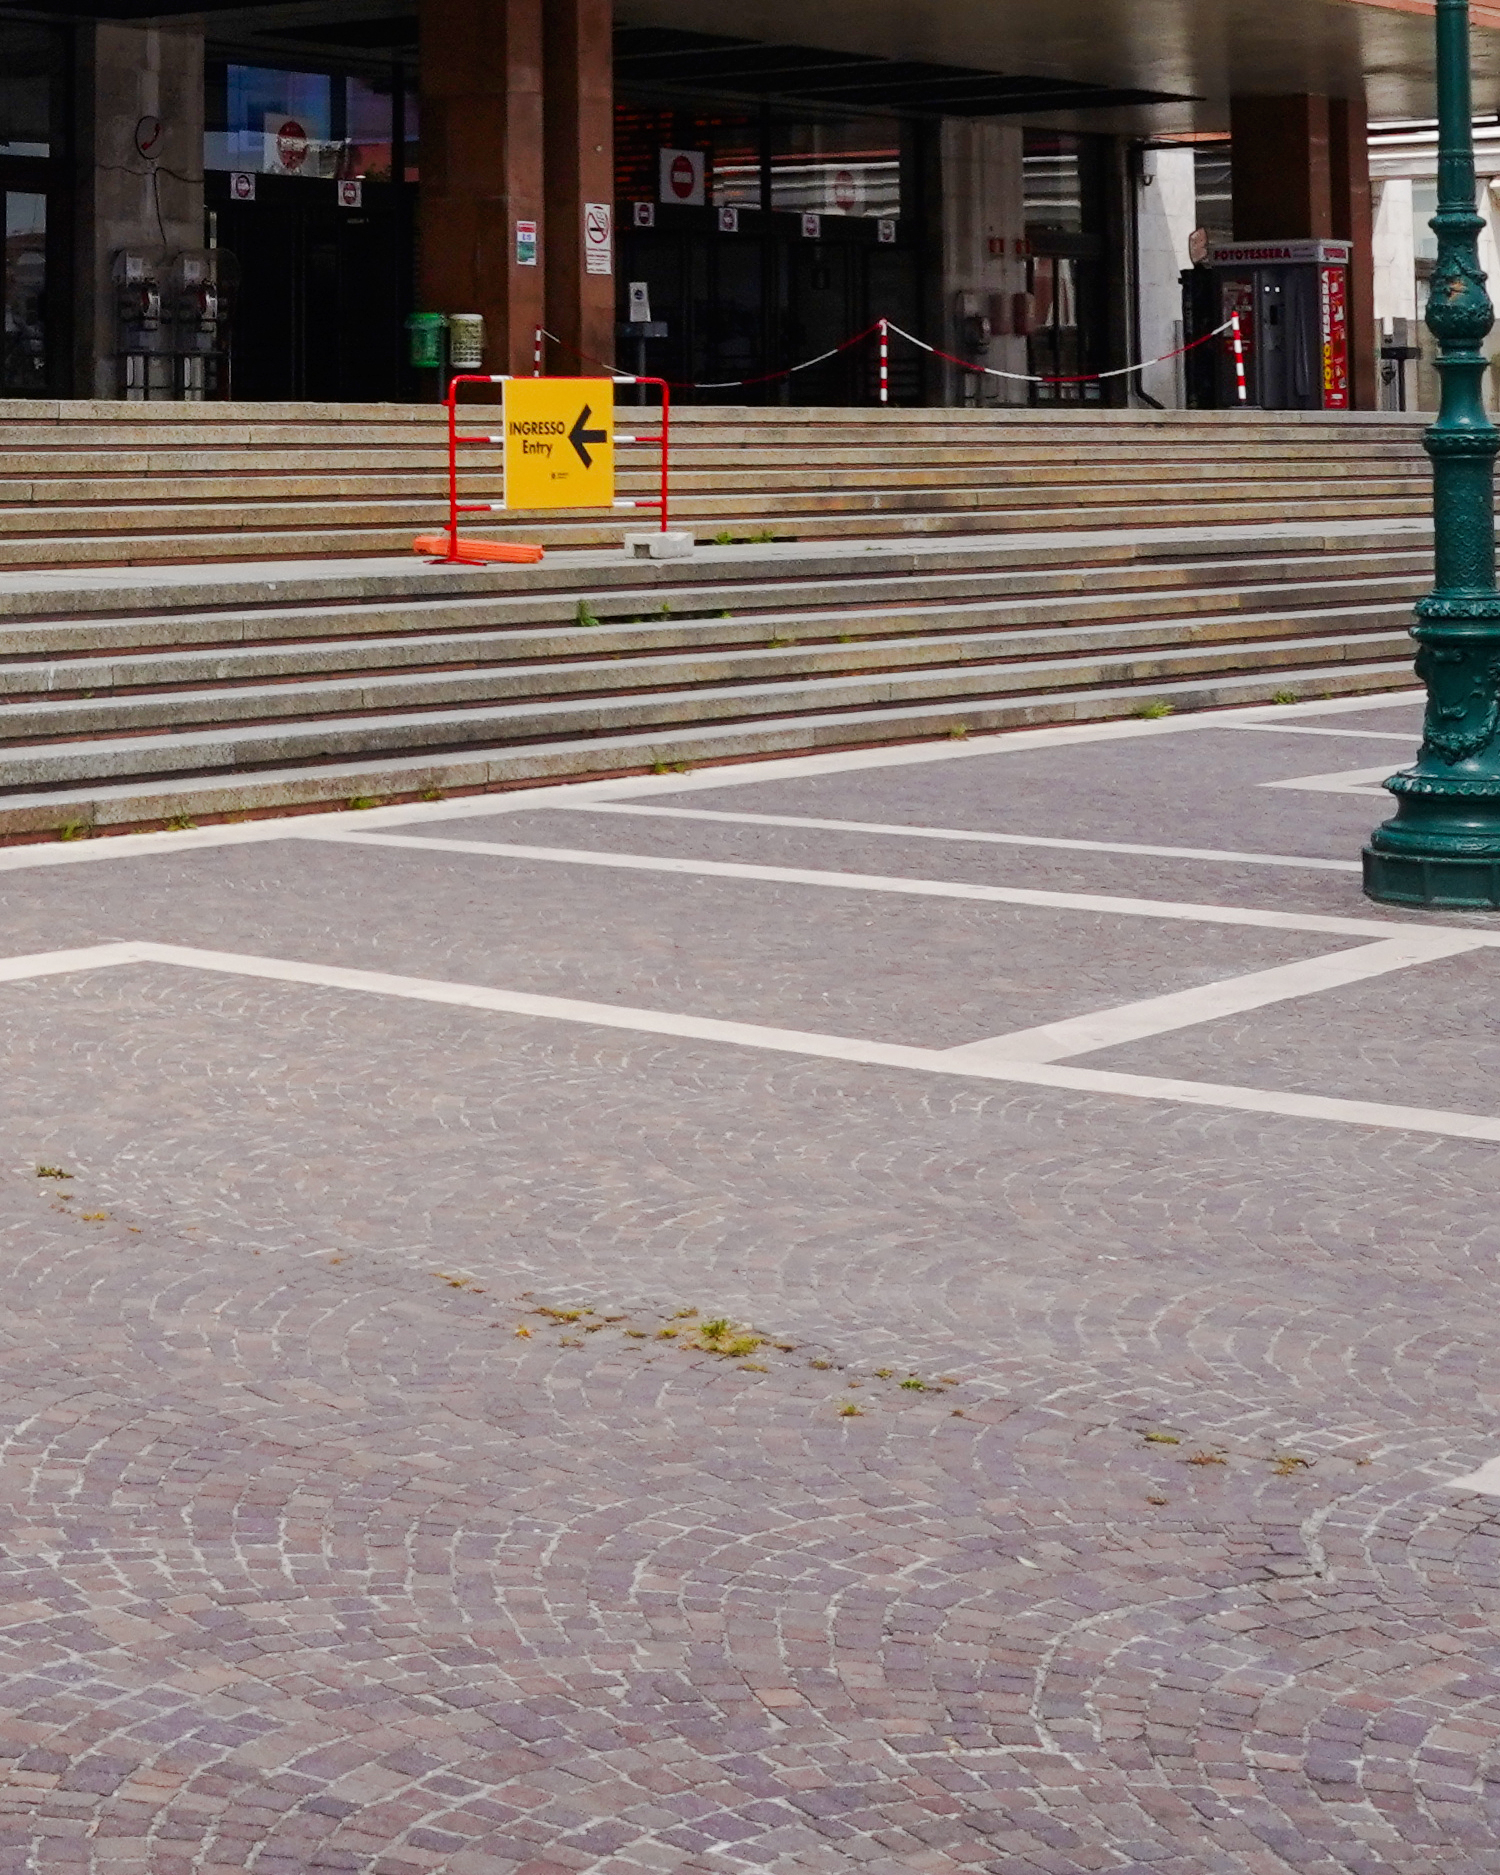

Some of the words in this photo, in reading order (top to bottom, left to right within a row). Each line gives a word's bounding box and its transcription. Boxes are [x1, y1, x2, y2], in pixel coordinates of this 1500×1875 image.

[1214, 247, 1291, 260] FOTOTESSERA
[509, 421, 565, 436] INGRESSO
[522, 439, 553, 458] Entry
